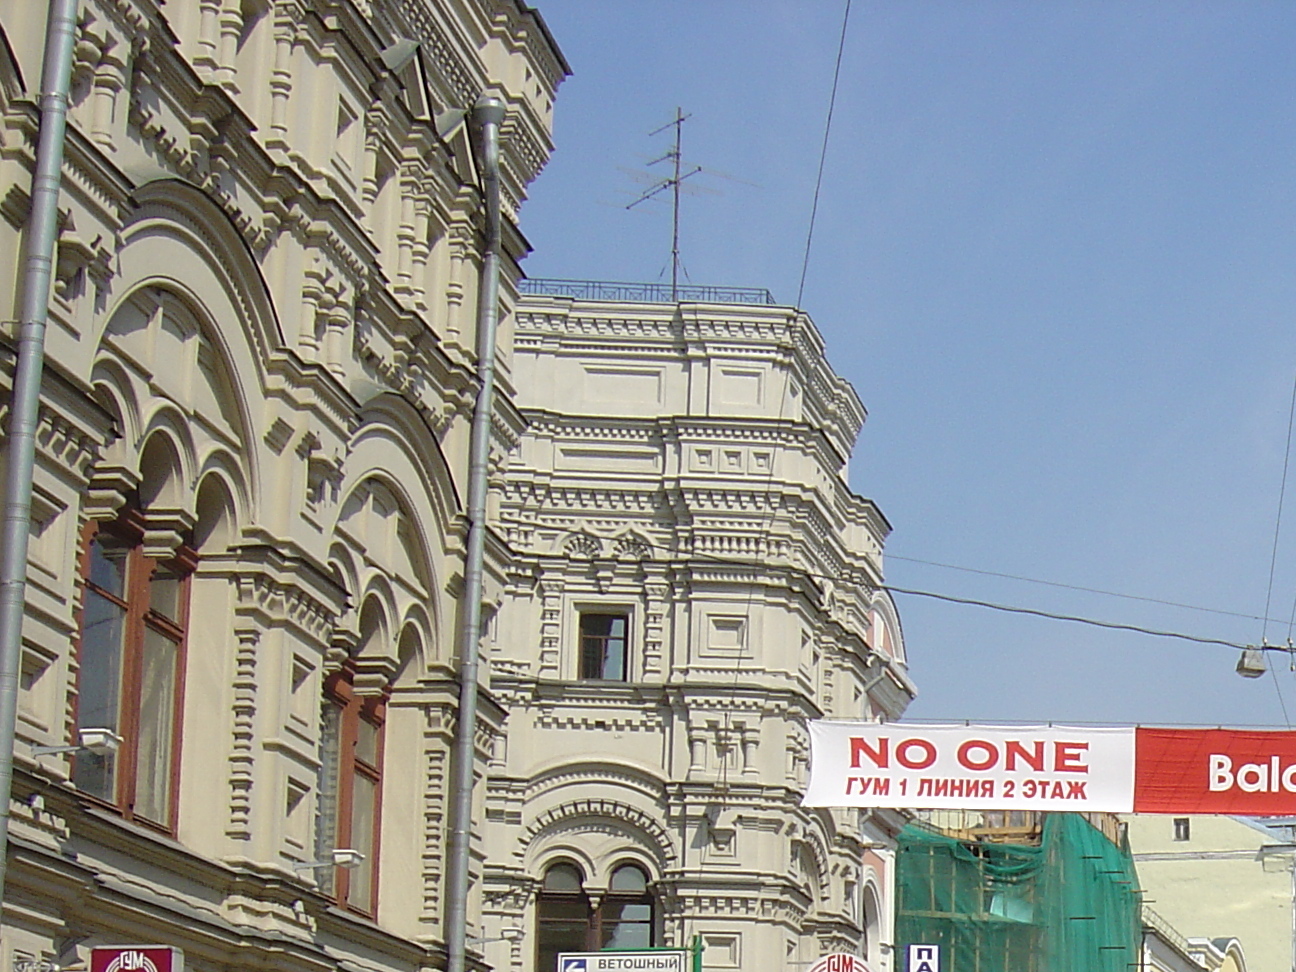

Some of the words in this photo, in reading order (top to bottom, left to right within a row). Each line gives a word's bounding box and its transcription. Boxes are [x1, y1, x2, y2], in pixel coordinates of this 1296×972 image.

[849, 737, 937, 770] NO
[957, 739, 1089, 774] ONE
[845, 776, 890, 796] ГУМ
[899, 778, 908, 796] 1
[917, 777, 995, 798] ЛИНИЯ
[1003, 779, 1015, 798] 2
[1022, 779, 1087, 800] ЭТАЖ
[120, 951, 144, 970] ГУМ
[598, 956, 678, 969] ВЕТОШНЫЙ
